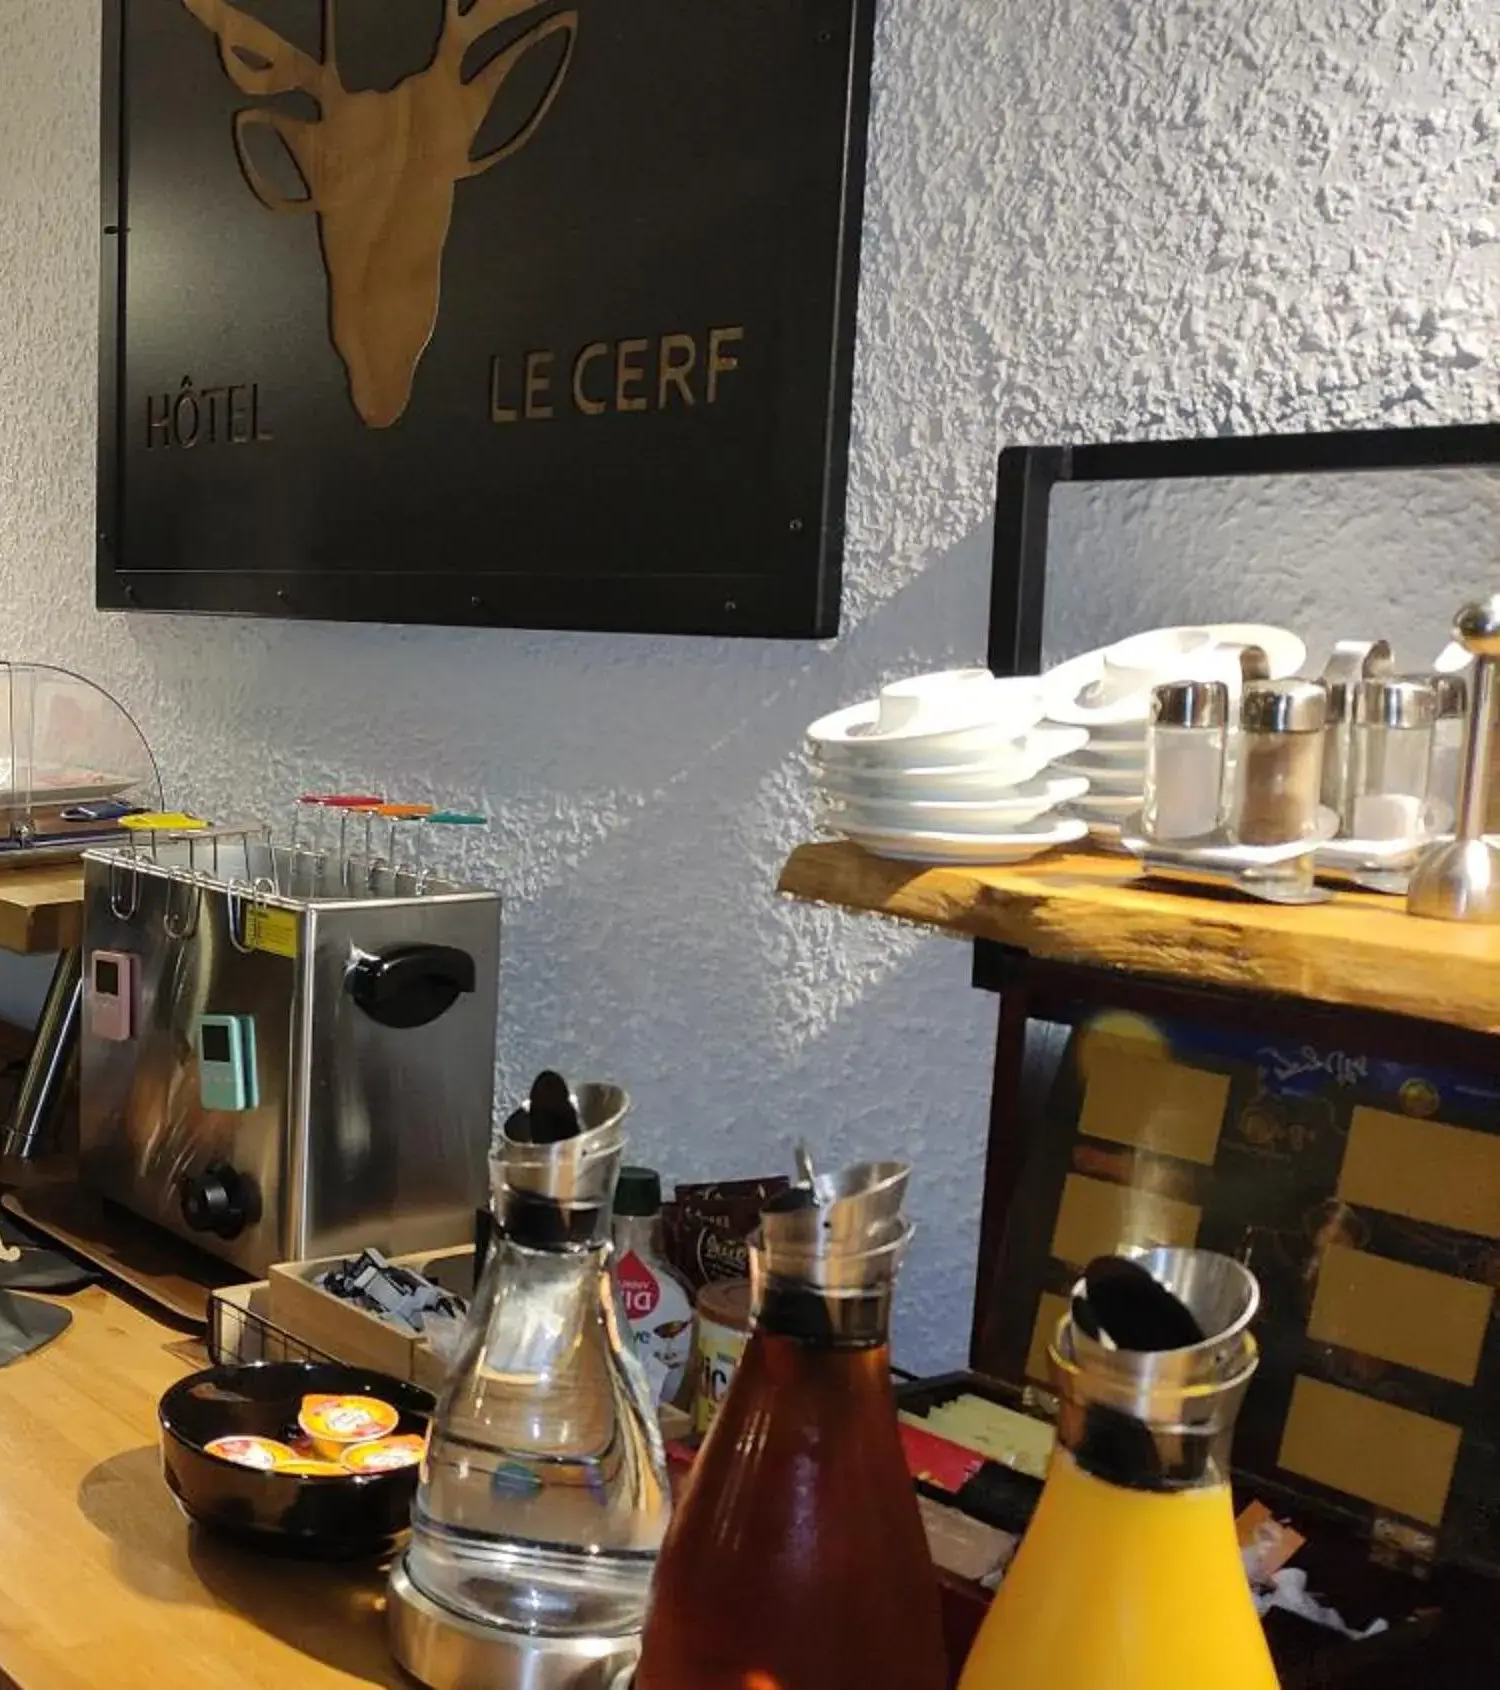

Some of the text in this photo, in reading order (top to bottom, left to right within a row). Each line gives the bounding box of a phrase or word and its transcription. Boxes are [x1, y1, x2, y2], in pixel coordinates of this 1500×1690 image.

[146, 375, 274, 449] HÔTEL
[490, 325, 745, 424] LE CERF
